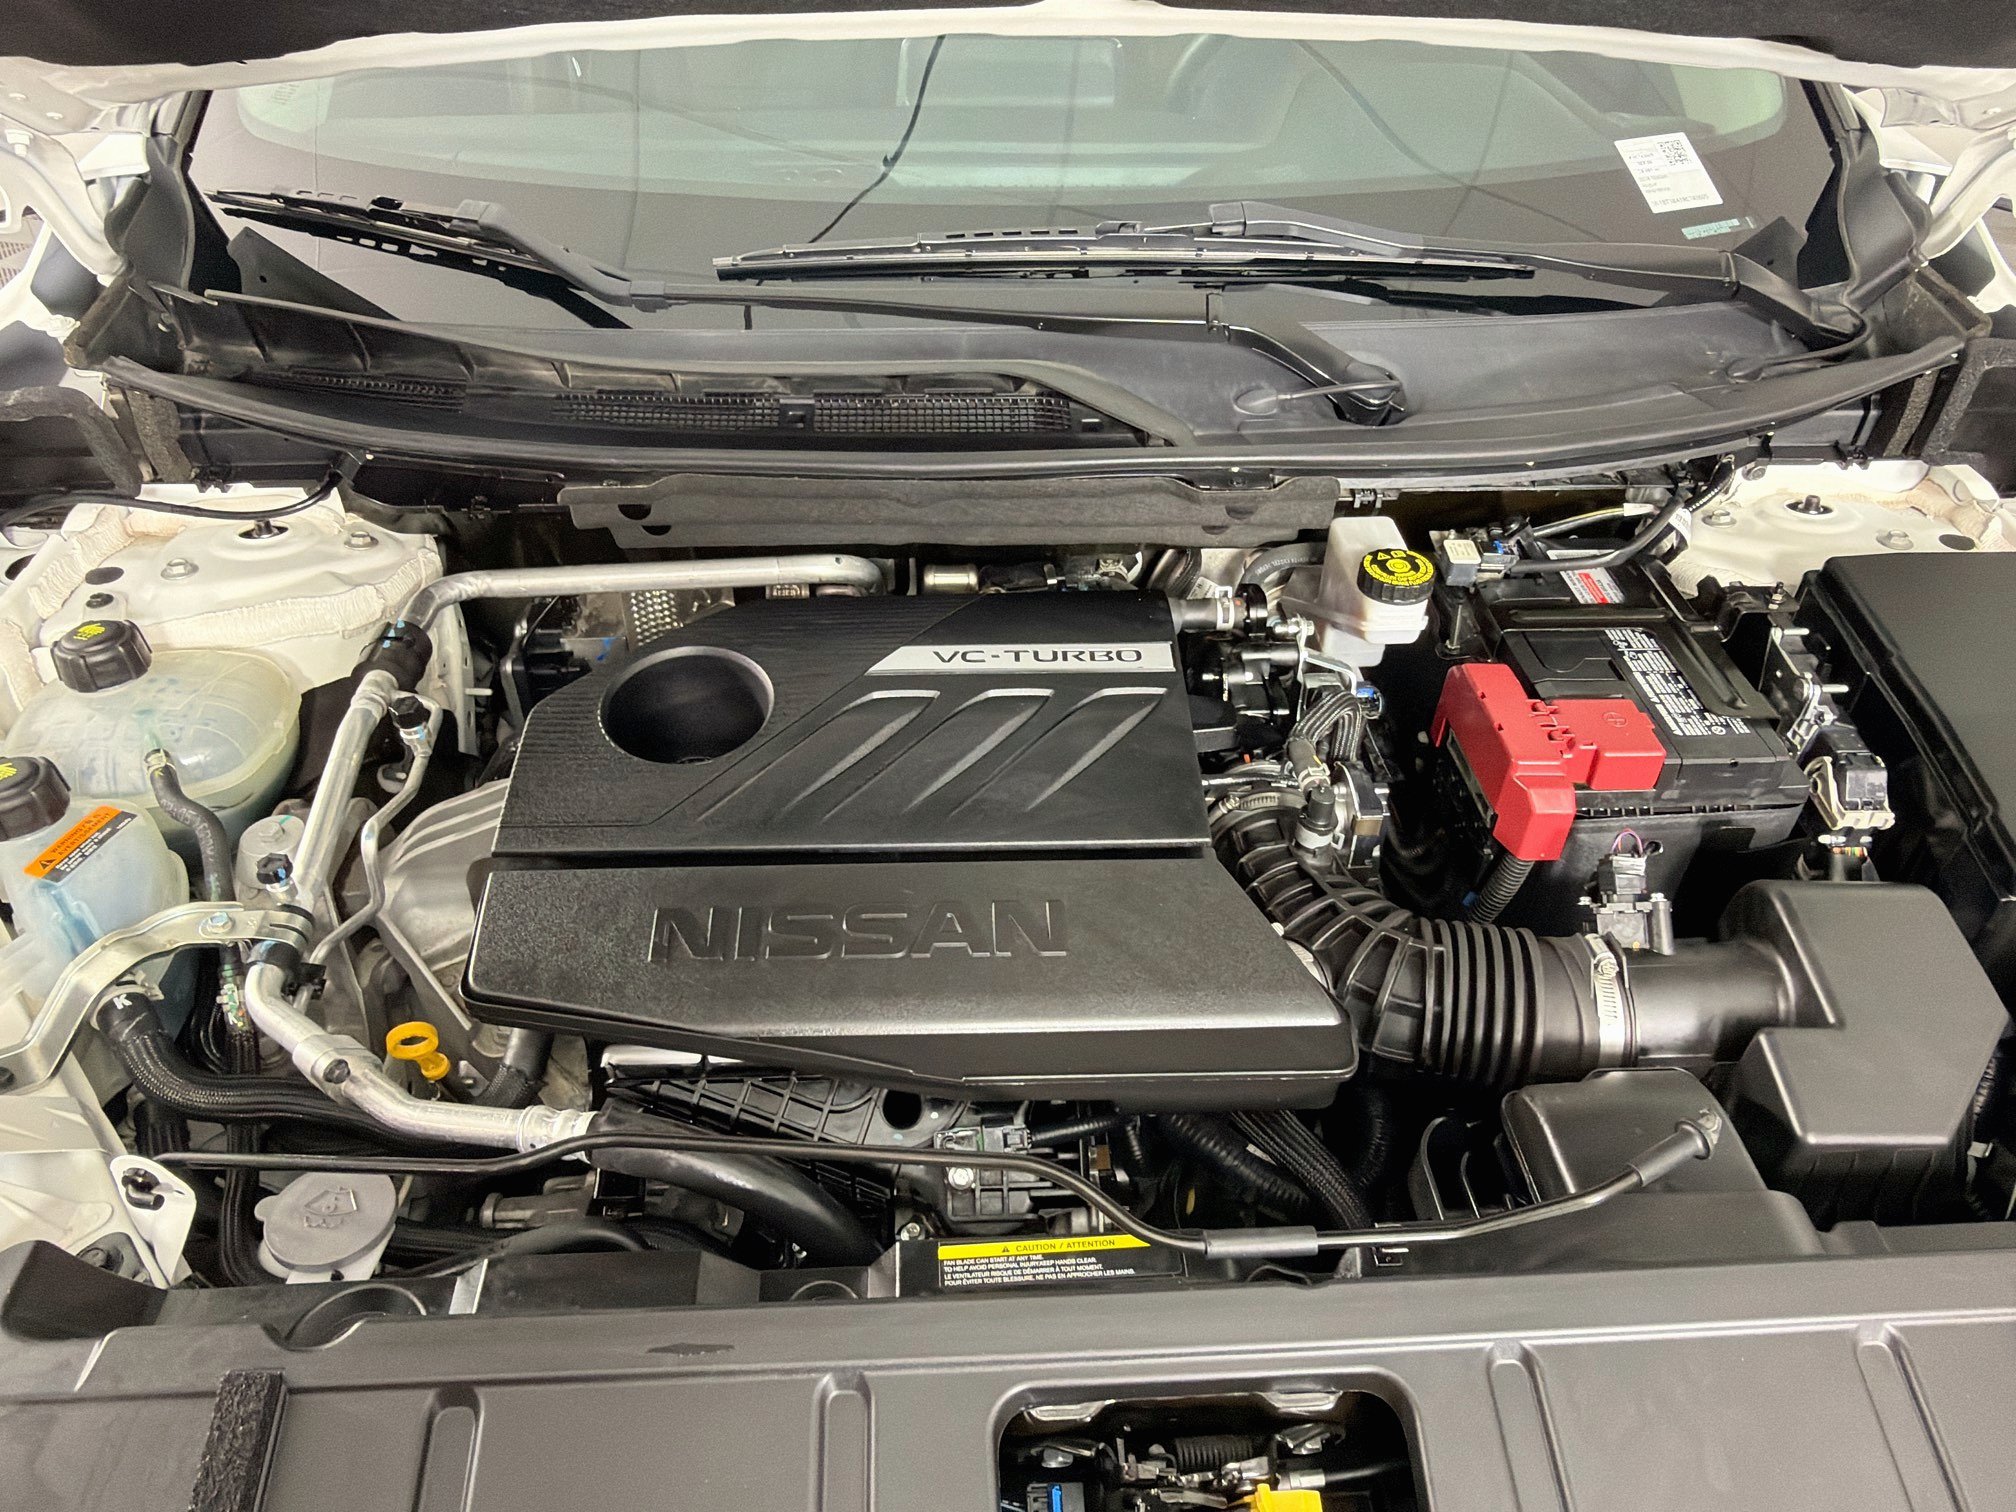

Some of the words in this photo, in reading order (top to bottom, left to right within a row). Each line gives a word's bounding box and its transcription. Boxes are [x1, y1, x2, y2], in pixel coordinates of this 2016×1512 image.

[932, 648, 1143, 663] VC-TURBO
[647, 899, 1068, 962] NISSAN
[1015, 1243, 1056, 1252] CAUTION
[1066, 1239, 1115, 1249] ATTENTION
